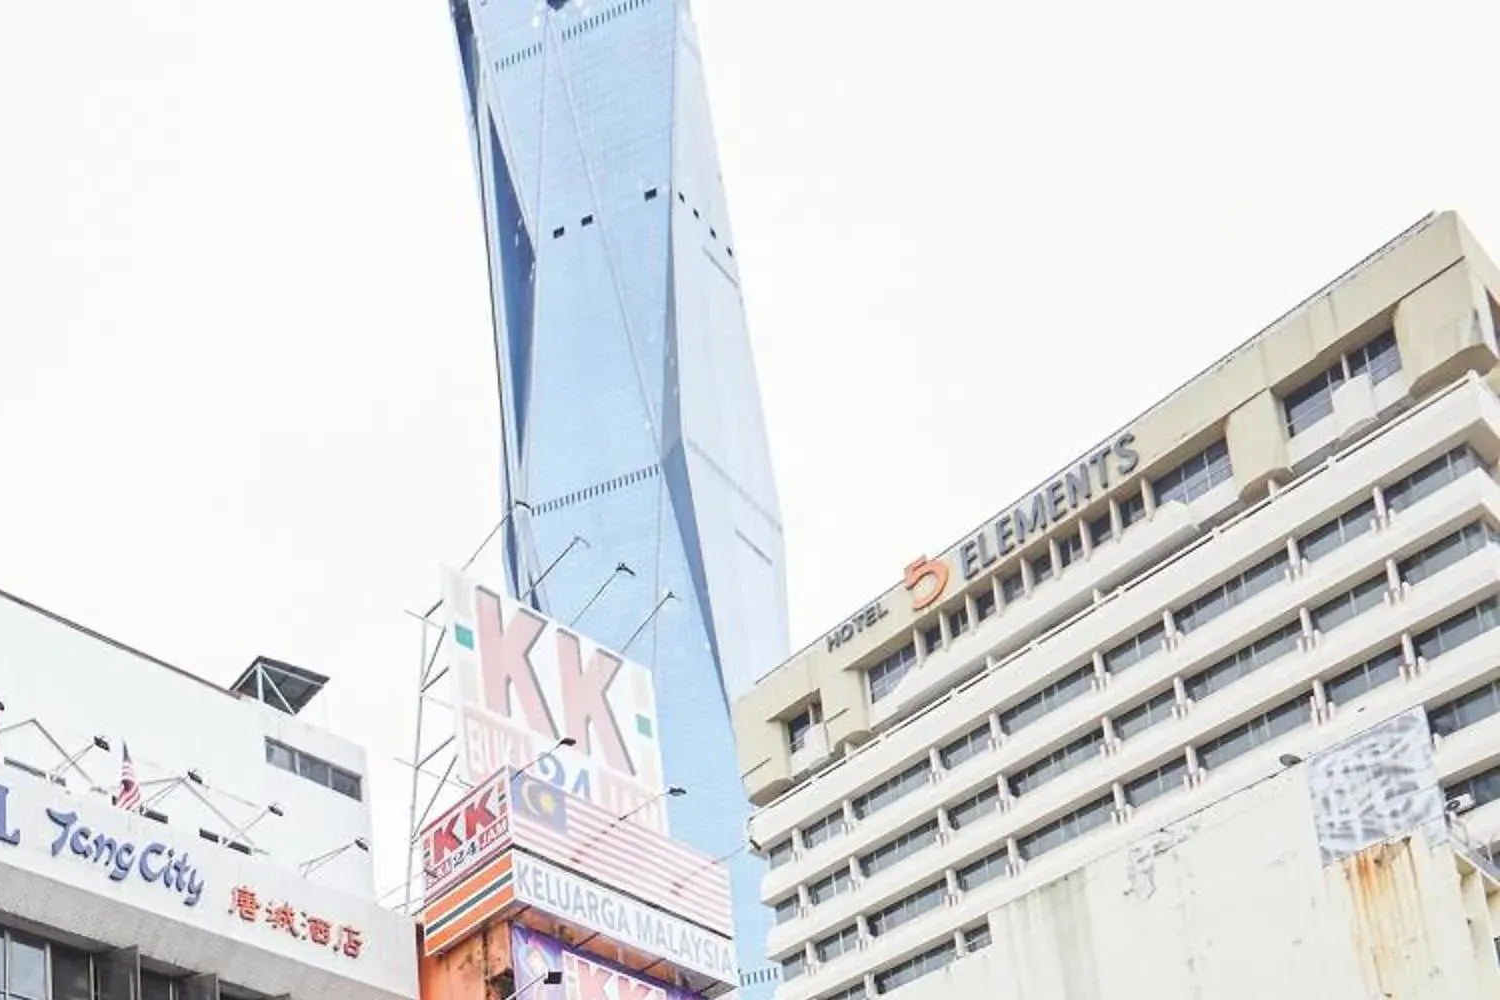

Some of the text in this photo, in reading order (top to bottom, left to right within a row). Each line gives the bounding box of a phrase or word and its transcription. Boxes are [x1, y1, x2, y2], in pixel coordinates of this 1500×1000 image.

[826, 433, 1140, 652] HOTEL 5 ELEMENTS
[476, 584, 637, 776] KK
[46, 806, 134, 882] Tang
[138, 844, 205, 907] City
[433, 785, 498, 865] KK
[227, 885, 363, 959] 唐城酒店
[516, 861, 631, 938] KELUARGA
[635, 907, 735, 977] MALAYSIA
